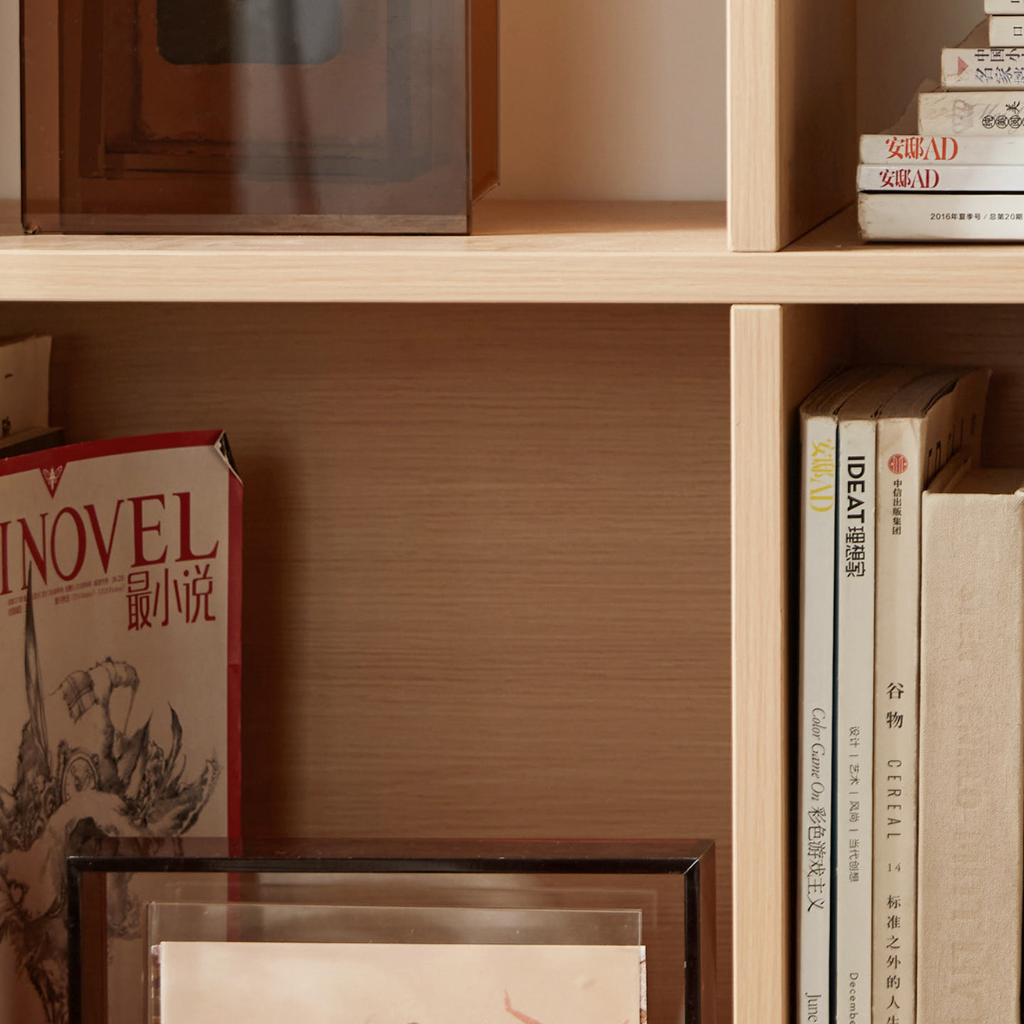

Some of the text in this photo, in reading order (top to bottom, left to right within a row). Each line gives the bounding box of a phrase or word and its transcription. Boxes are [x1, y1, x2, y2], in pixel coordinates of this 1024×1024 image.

[845, 456, 866, 578] IDEAT 理想家
[126, 564, 216, 631] 最小说
[886, 682, 905, 729] 谷物
[849, 726, 860, 749] 设计
[849, 764, 860, 786] 艺术
[849, 801, 860, 823] 风尚
[887, 759, 902, 839] CEREAL
[805, 707, 827, 1023] Color Game On 彩色游戏主义 June
[887, 863, 902, 872] 14
